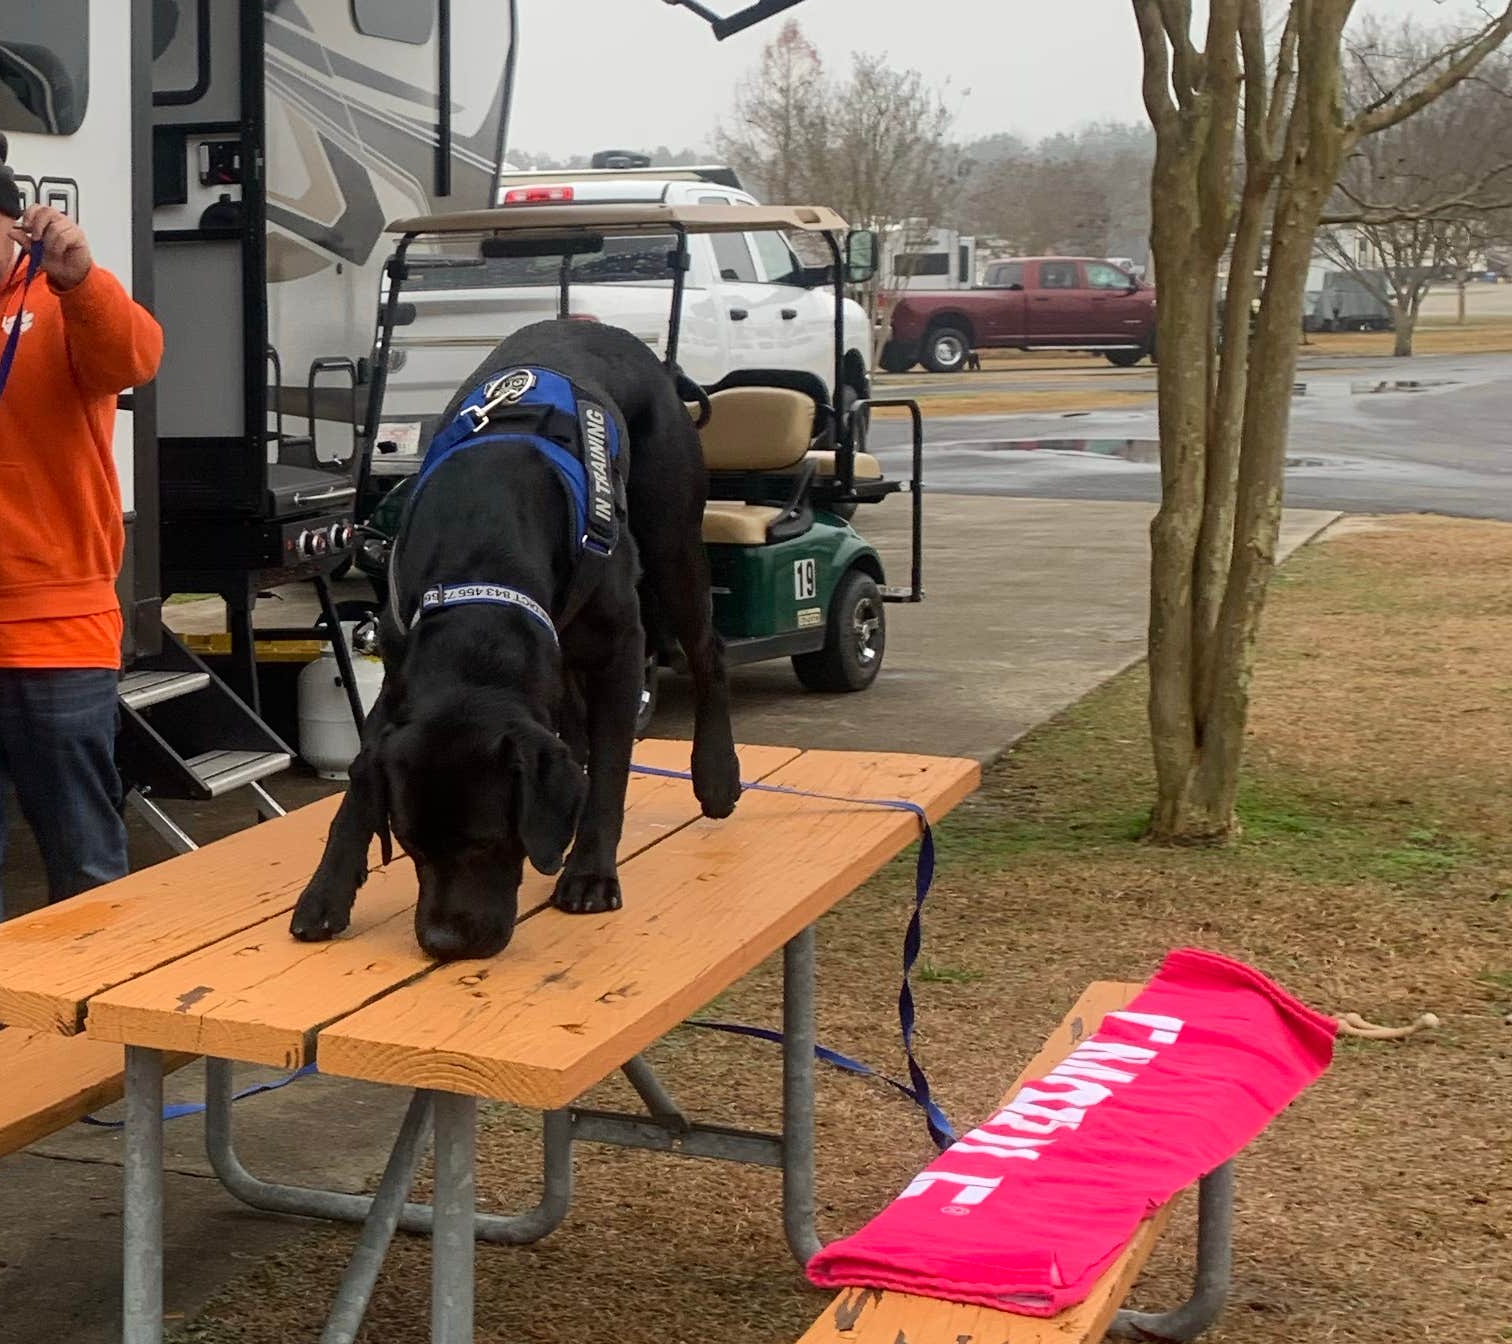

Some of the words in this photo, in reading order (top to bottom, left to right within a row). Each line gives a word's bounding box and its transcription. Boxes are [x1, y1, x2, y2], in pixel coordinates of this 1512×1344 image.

[586, 409, 611, 495] TRAINING
[595, 497, 611, 522] IN
[797, 561, 814, 598] 19
